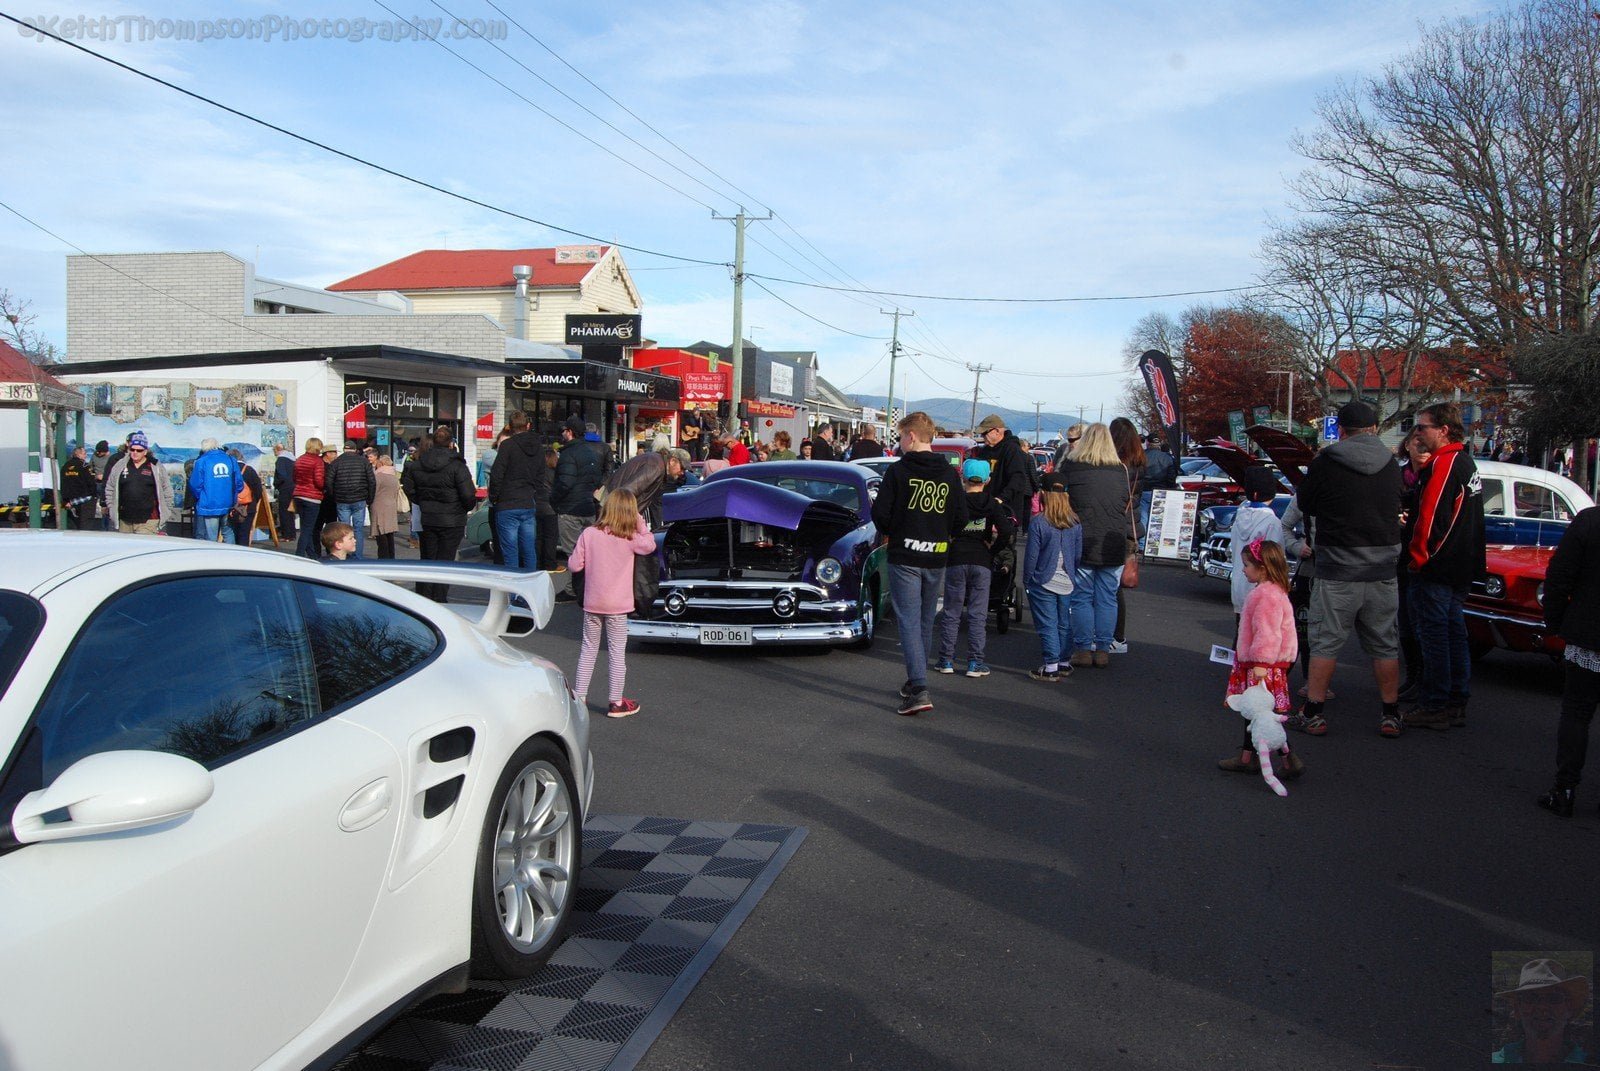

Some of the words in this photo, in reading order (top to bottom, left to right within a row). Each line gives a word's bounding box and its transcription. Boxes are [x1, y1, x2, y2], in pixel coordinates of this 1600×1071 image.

[570, 327, 634, 337] PHARMACY
[521, 375, 581, 384] PHARMACY
[9, 384, 33, 399] 1878
[618, 379, 648, 393] PHARMACY
[363, 388, 389, 409] Little
[393, 391, 432, 412] Elephant
[346, 421, 365, 429] OPEN
[1327, 418, 1336, 427] P
[908, 478, 950, 513] 788
